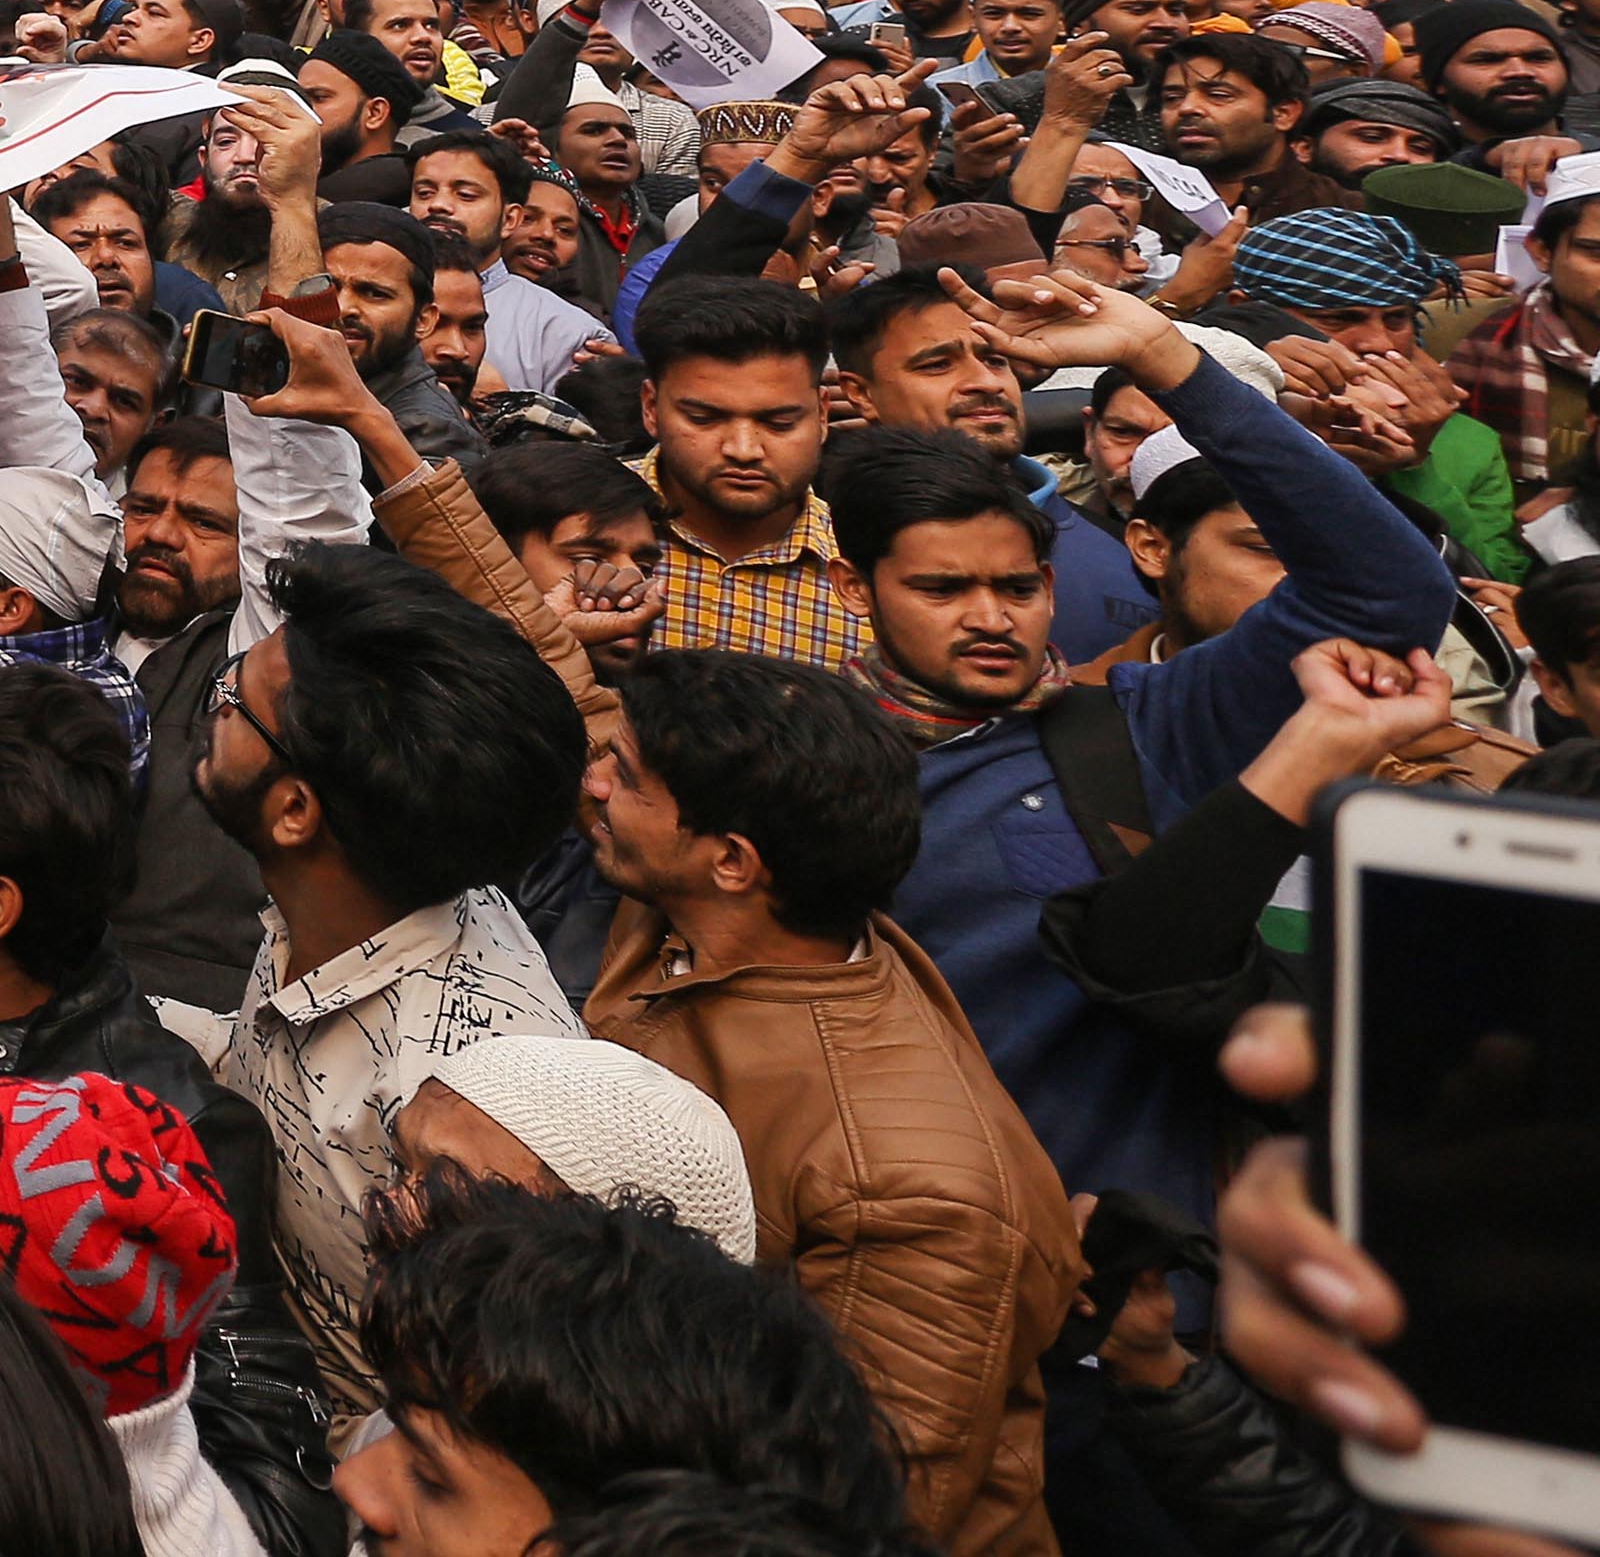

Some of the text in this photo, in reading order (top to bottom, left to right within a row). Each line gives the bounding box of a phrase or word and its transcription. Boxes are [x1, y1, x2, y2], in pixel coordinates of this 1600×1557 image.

[701, 22, 736, 55] विरोध
[698, 38, 740, 77] NRC
[732, 51, 752, 67] का
